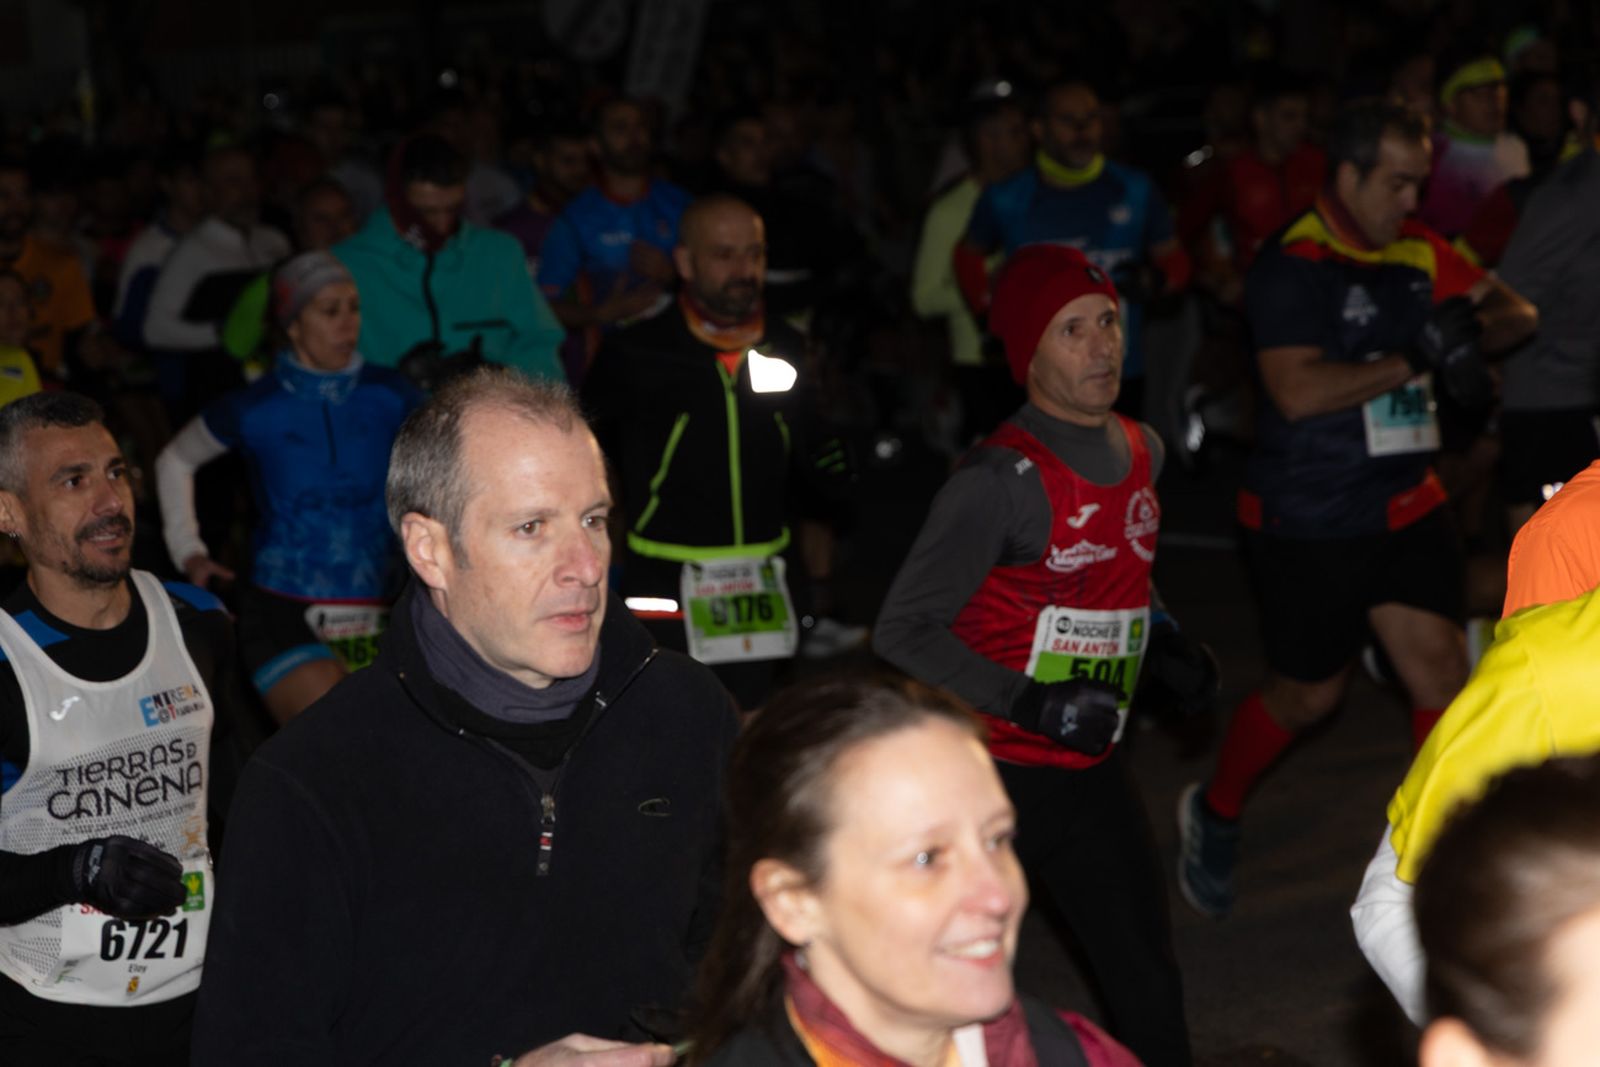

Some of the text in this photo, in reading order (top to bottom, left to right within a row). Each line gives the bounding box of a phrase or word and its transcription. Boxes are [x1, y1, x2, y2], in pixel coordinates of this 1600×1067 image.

[711, 593, 774, 628] 9176
[1072, 625, 1109, 638] NOCHE
[1051, 639, 1081, 653] SAN
[100, 918, 187, 961] 6721
